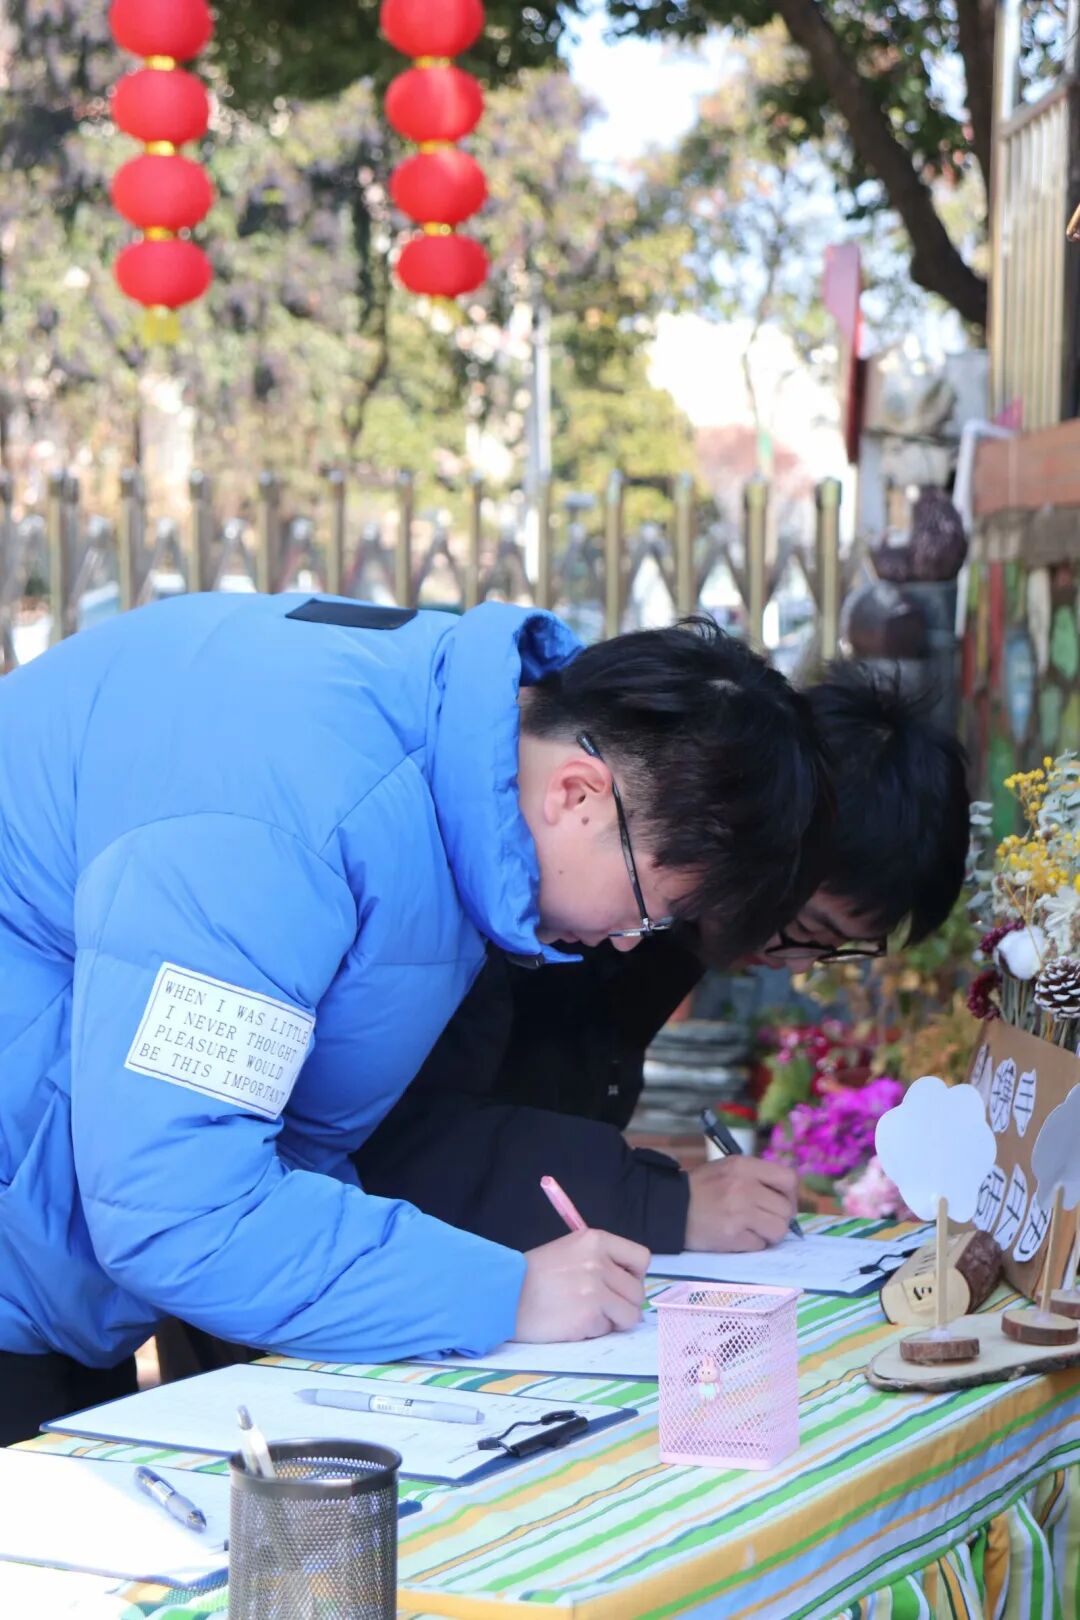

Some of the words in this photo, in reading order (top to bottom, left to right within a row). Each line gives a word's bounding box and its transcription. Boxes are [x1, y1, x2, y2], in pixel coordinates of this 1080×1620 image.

[166, 980, 207, 1006] WHEN
[215, 999, 225, 1013] I
[237, 1004, 266, 1026] WAS
[154, 1024, 238, 1064] PLEASURE
[246, 1054, 284, 1081] WOULD
[165, 1005, 176, 1020] I
[183, 1011, 237, 1041] NEVER
[246, 1032, 297, 1064] THOUGHT
[139, 1042, 161, 1062] BE
[171, 1052, 212, 1079] THIS
[222, 1070, 286, 1105] IMPORTANT
